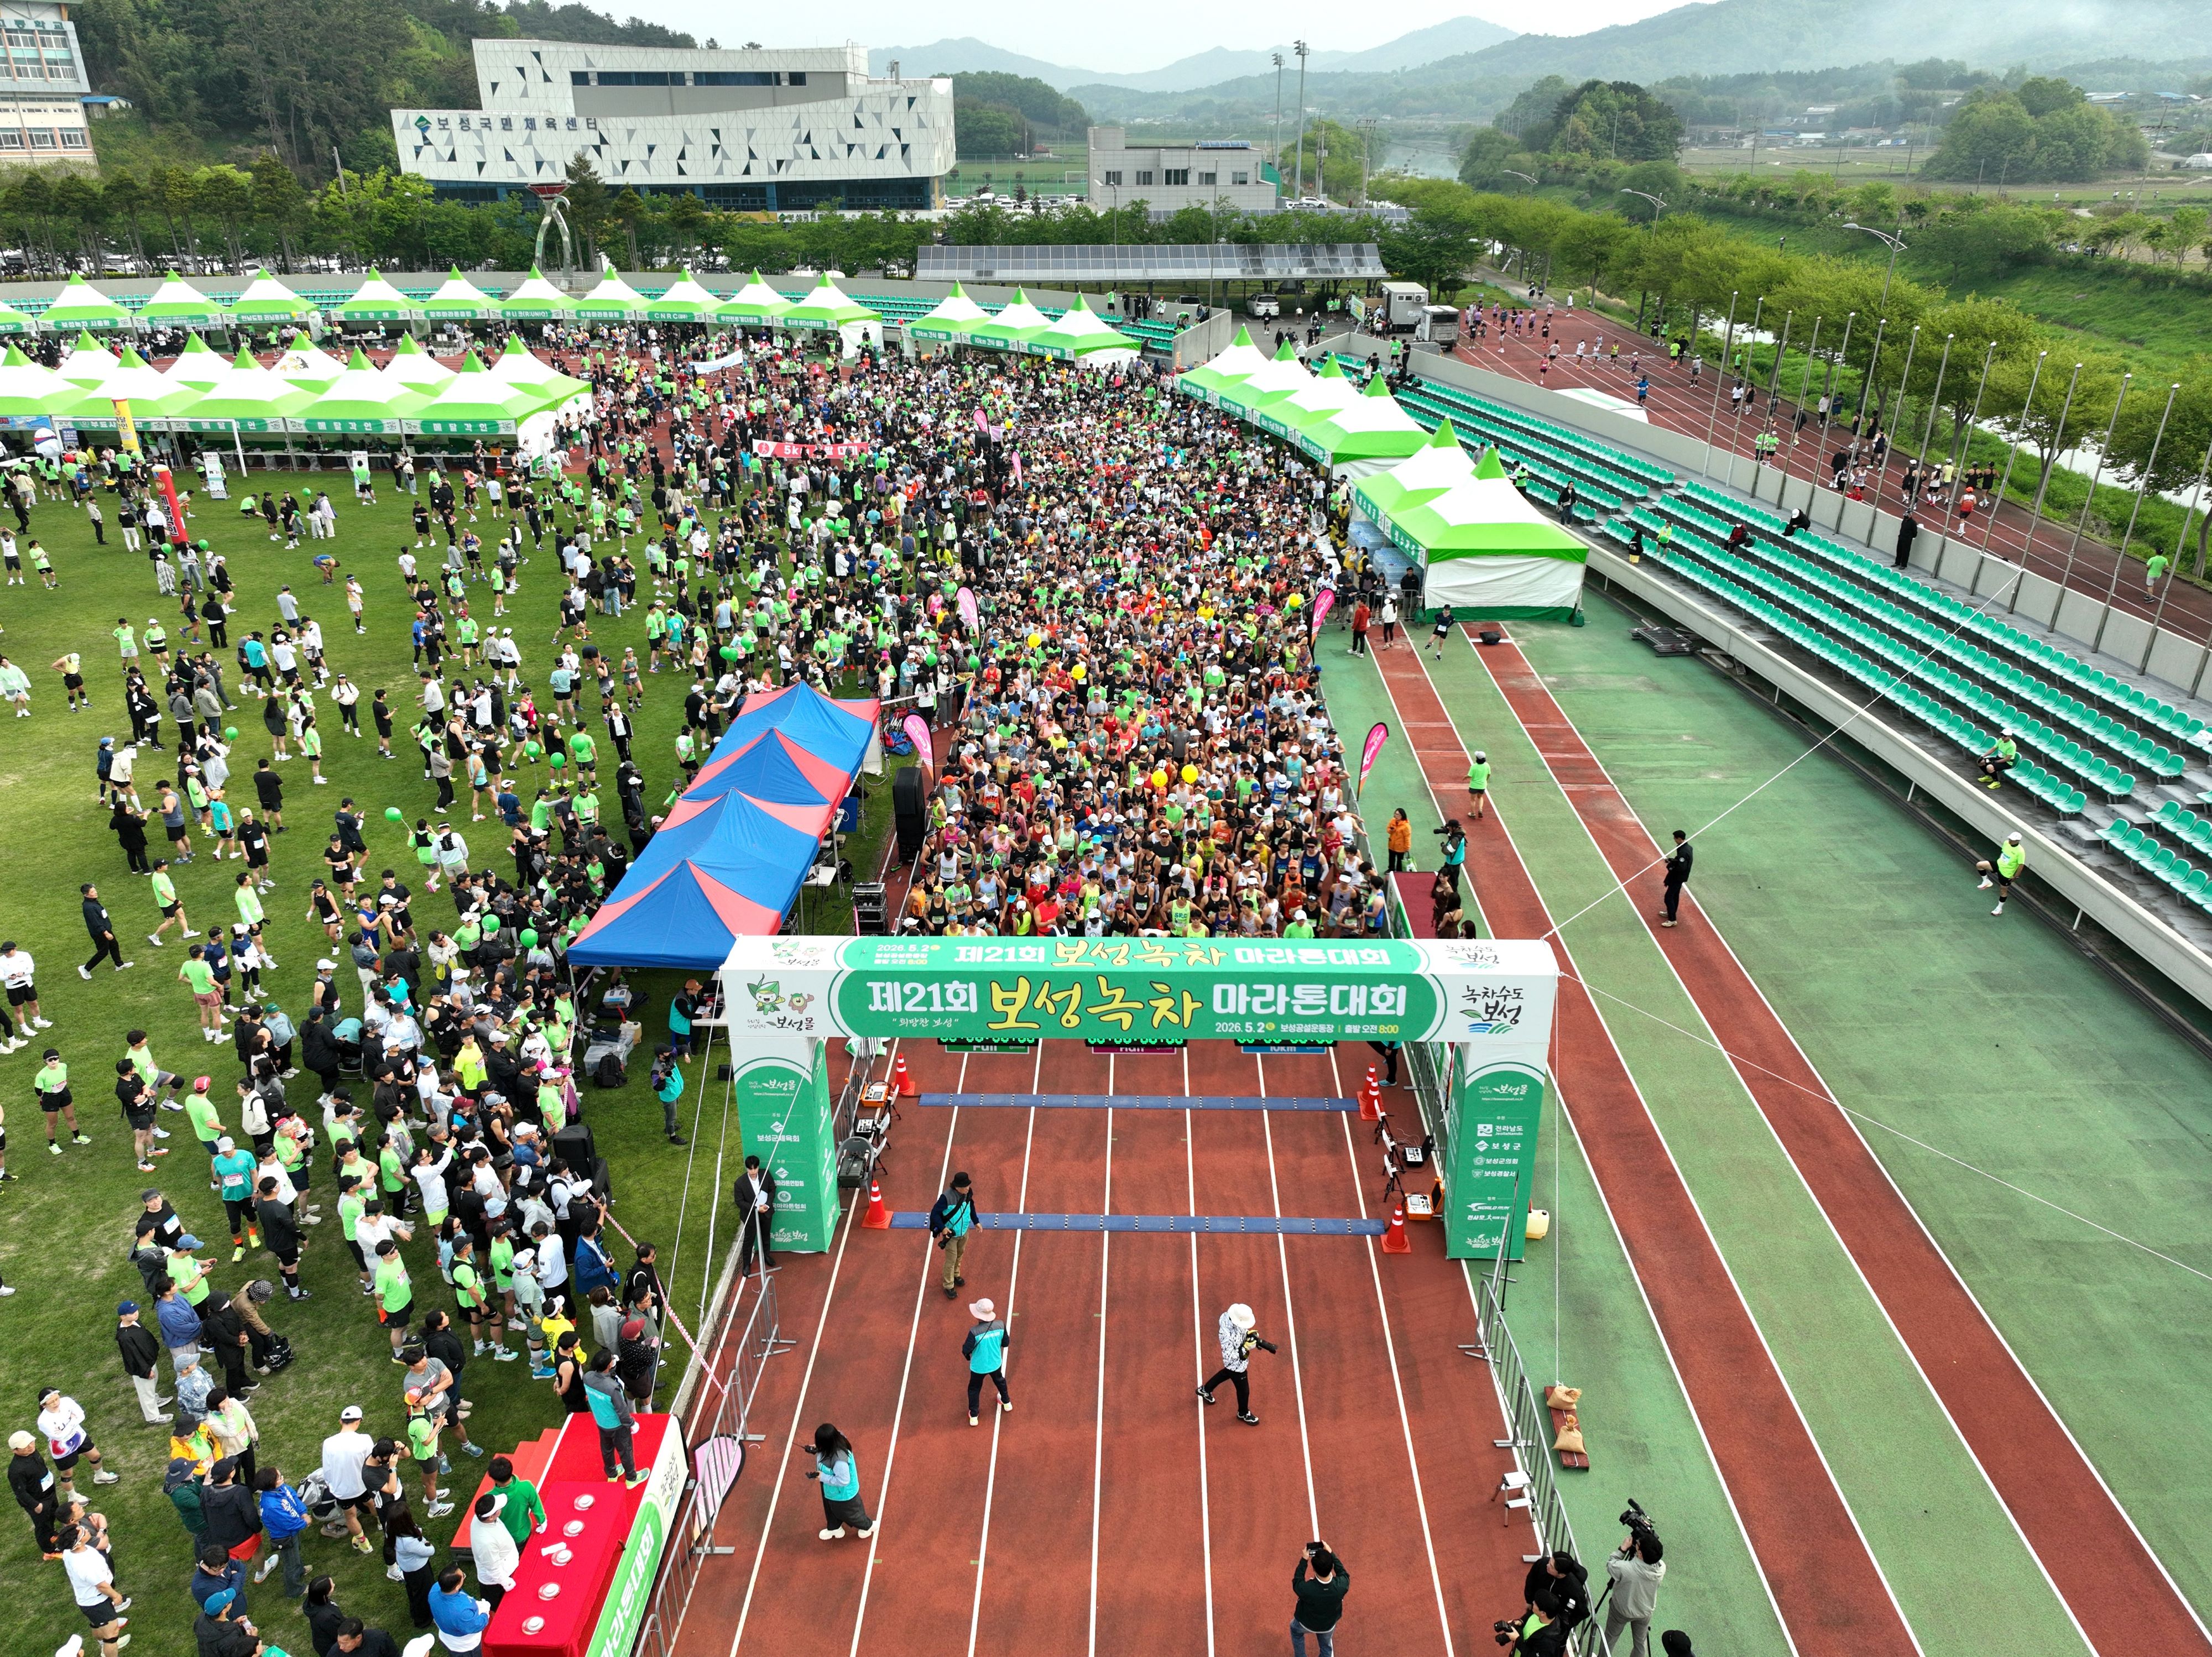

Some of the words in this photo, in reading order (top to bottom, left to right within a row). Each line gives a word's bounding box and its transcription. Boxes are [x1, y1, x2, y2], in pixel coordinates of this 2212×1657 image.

[437, 117, 598, 132] 보성국민체육센터
[1031, 346, 1044, 354] 10km
[953, 945, 1045, 963] 제21회
[1235, 947, 1391, 966] 마라톤대회
[1466, 953, 1500, 964] 보성
[867, 980, 978, 1013] 제21회
[1213, 983, 1406, 1017] 마라톤대회
[1462, 985, 1524, 1004] 녹차수도
[1482, 1000, 1522, 1025] 보성
[776, 1015, 815, 1031] 보성몰
[1215, 1022, 1243, 1033] 2026.
[1280, 1023, 1334, 1034] 보성공설운동장
[1344, 1023, 1360, 1034] 출발
[1361, 1023, 1378, 1034] 오전
[1379, 1024, 1400, 1034] 8:00
[769, 1079, 796, 1091] 보성몰
[1499, 1084, 1528, 1095] 보성몰
[1465, 1236, 1491, 1246] 녹차수도
